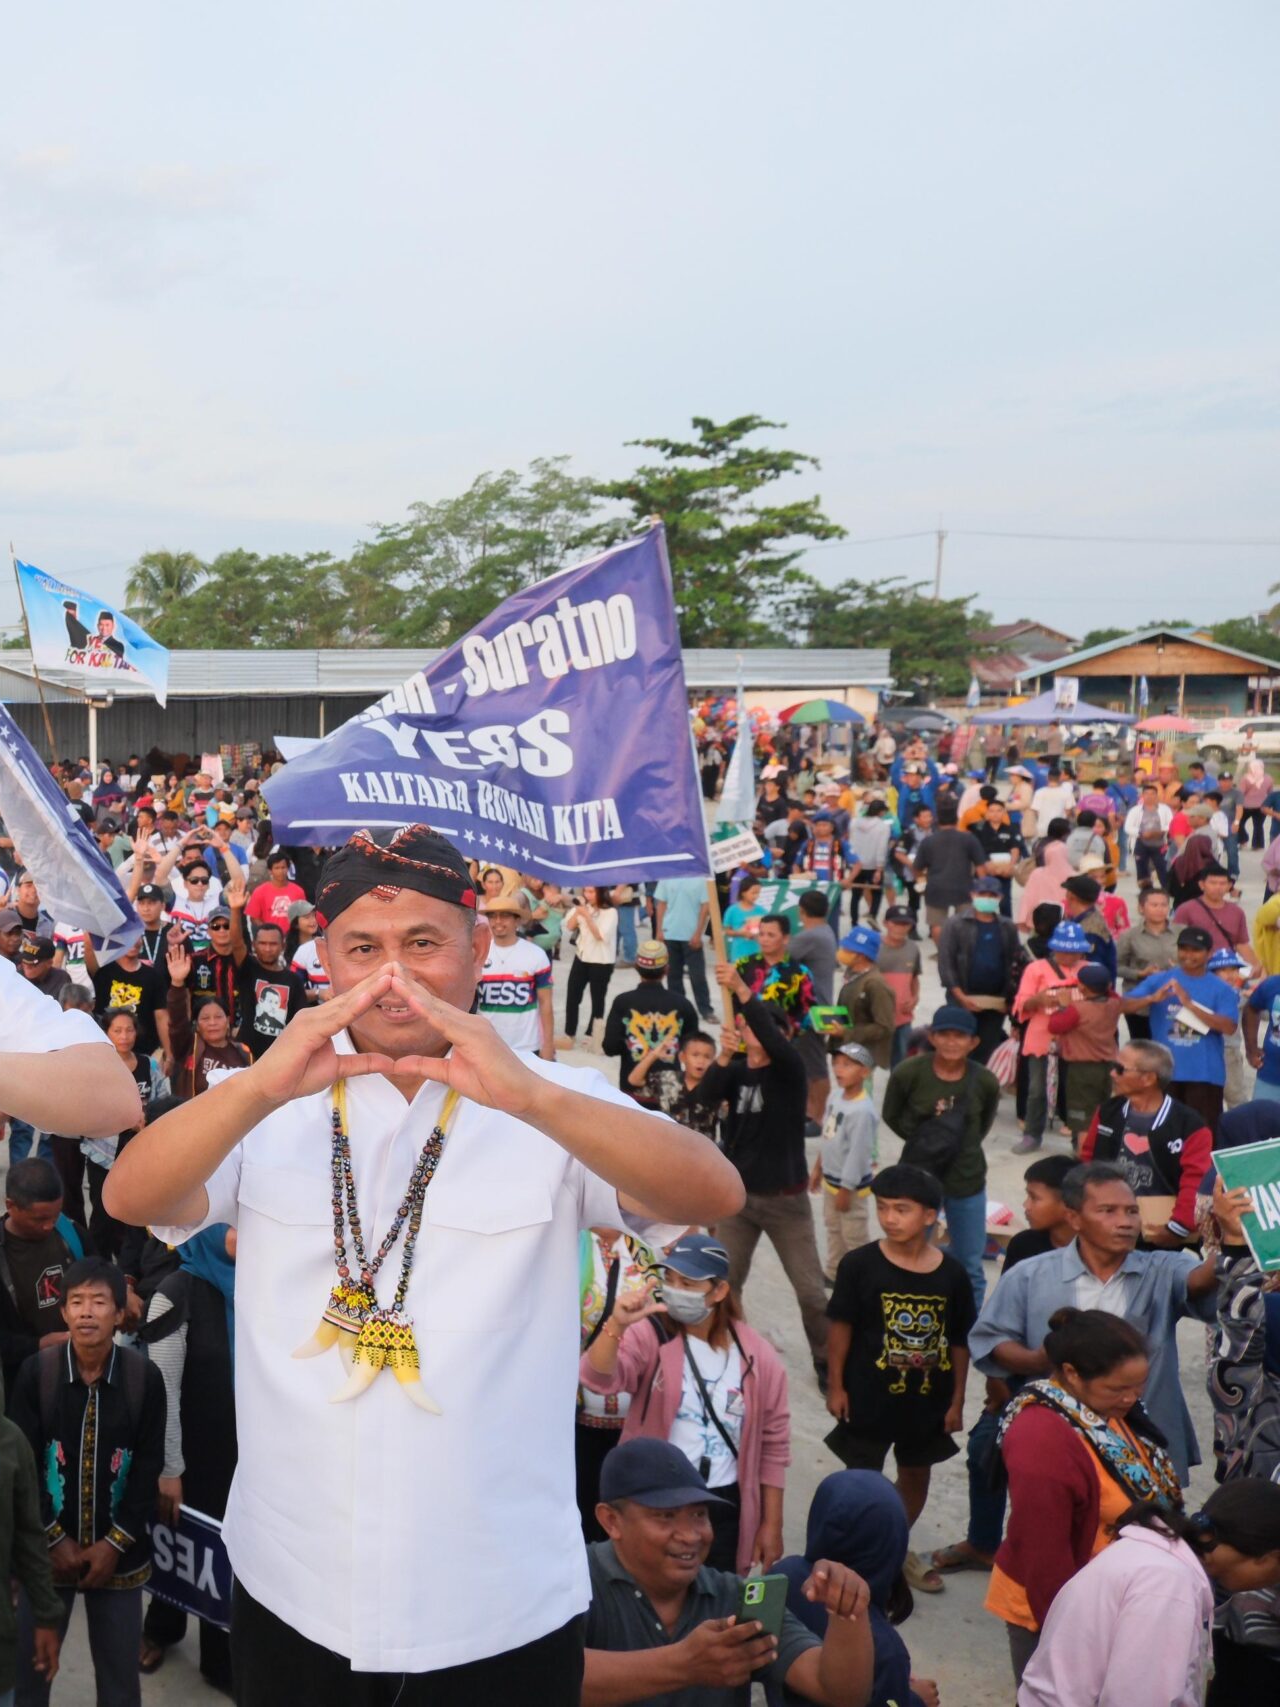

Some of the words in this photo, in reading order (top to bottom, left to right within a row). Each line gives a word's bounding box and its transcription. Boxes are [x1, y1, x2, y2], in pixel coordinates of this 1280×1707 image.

[462, 593, 637, 697] Suratno
[363, 709, 574, 777] YESS
[339, 772, 471, 814] KALTARA
[477, 778, 549, 842] RUMAH
[552, 797, 624, 845] KITA
